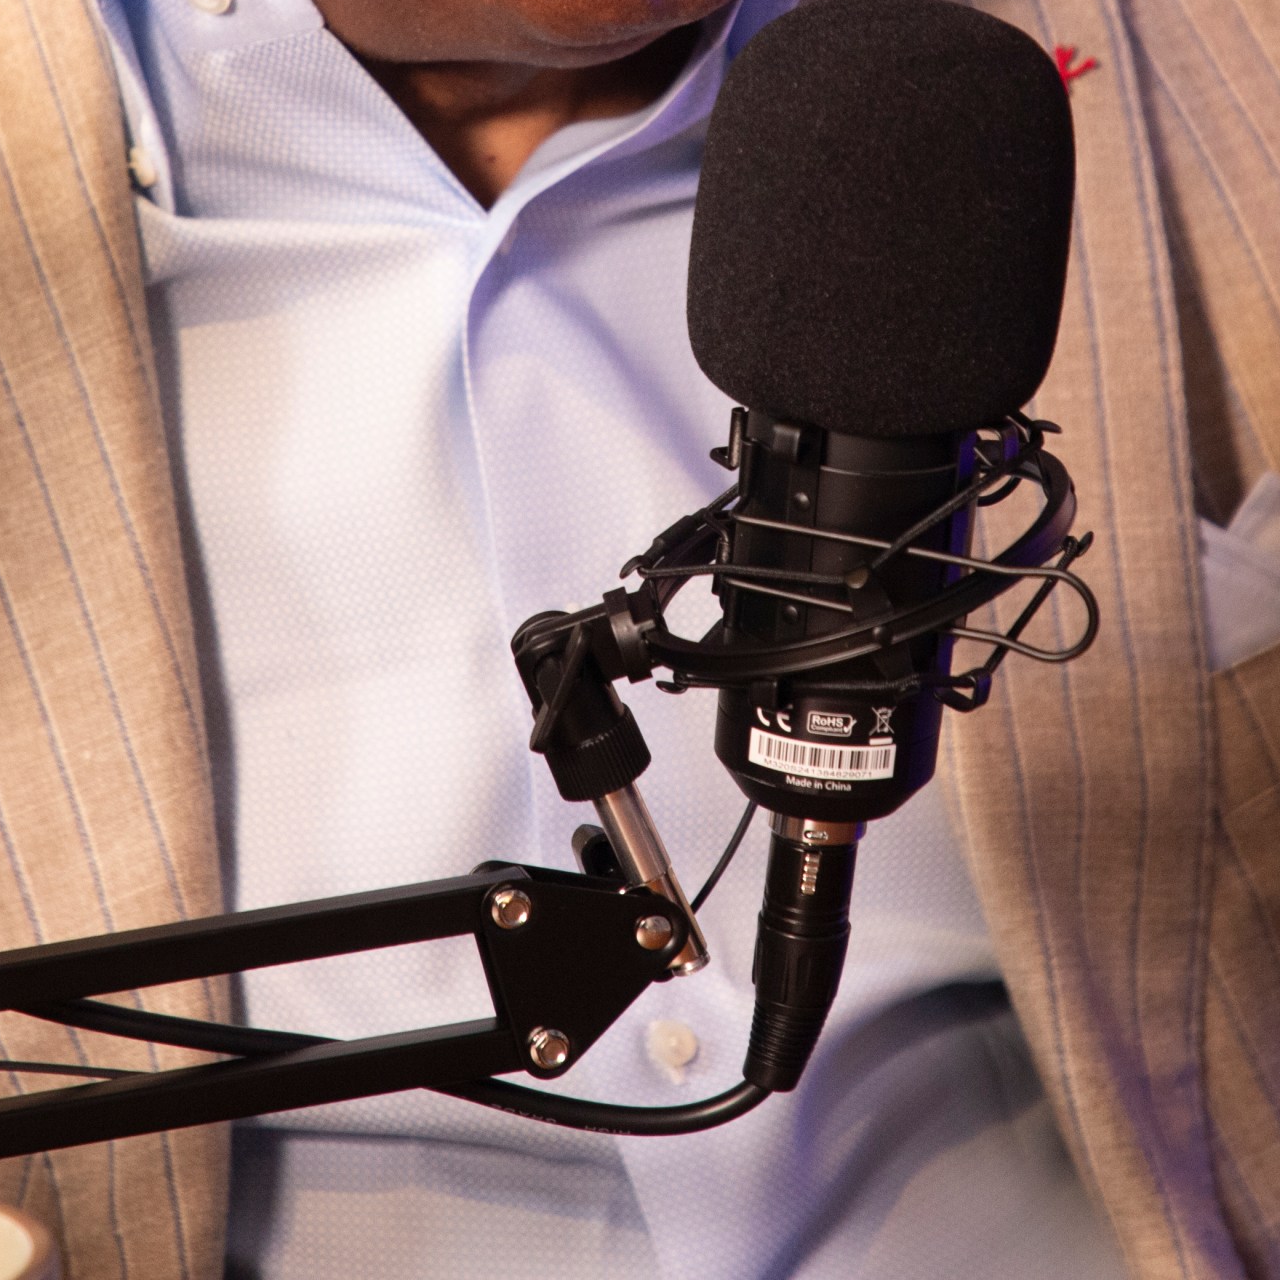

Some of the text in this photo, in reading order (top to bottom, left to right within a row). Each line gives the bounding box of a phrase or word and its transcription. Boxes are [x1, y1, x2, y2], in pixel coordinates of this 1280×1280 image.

[812, 714, 844, 728] RoHS
[785, 775, 852, 792] Made in China
